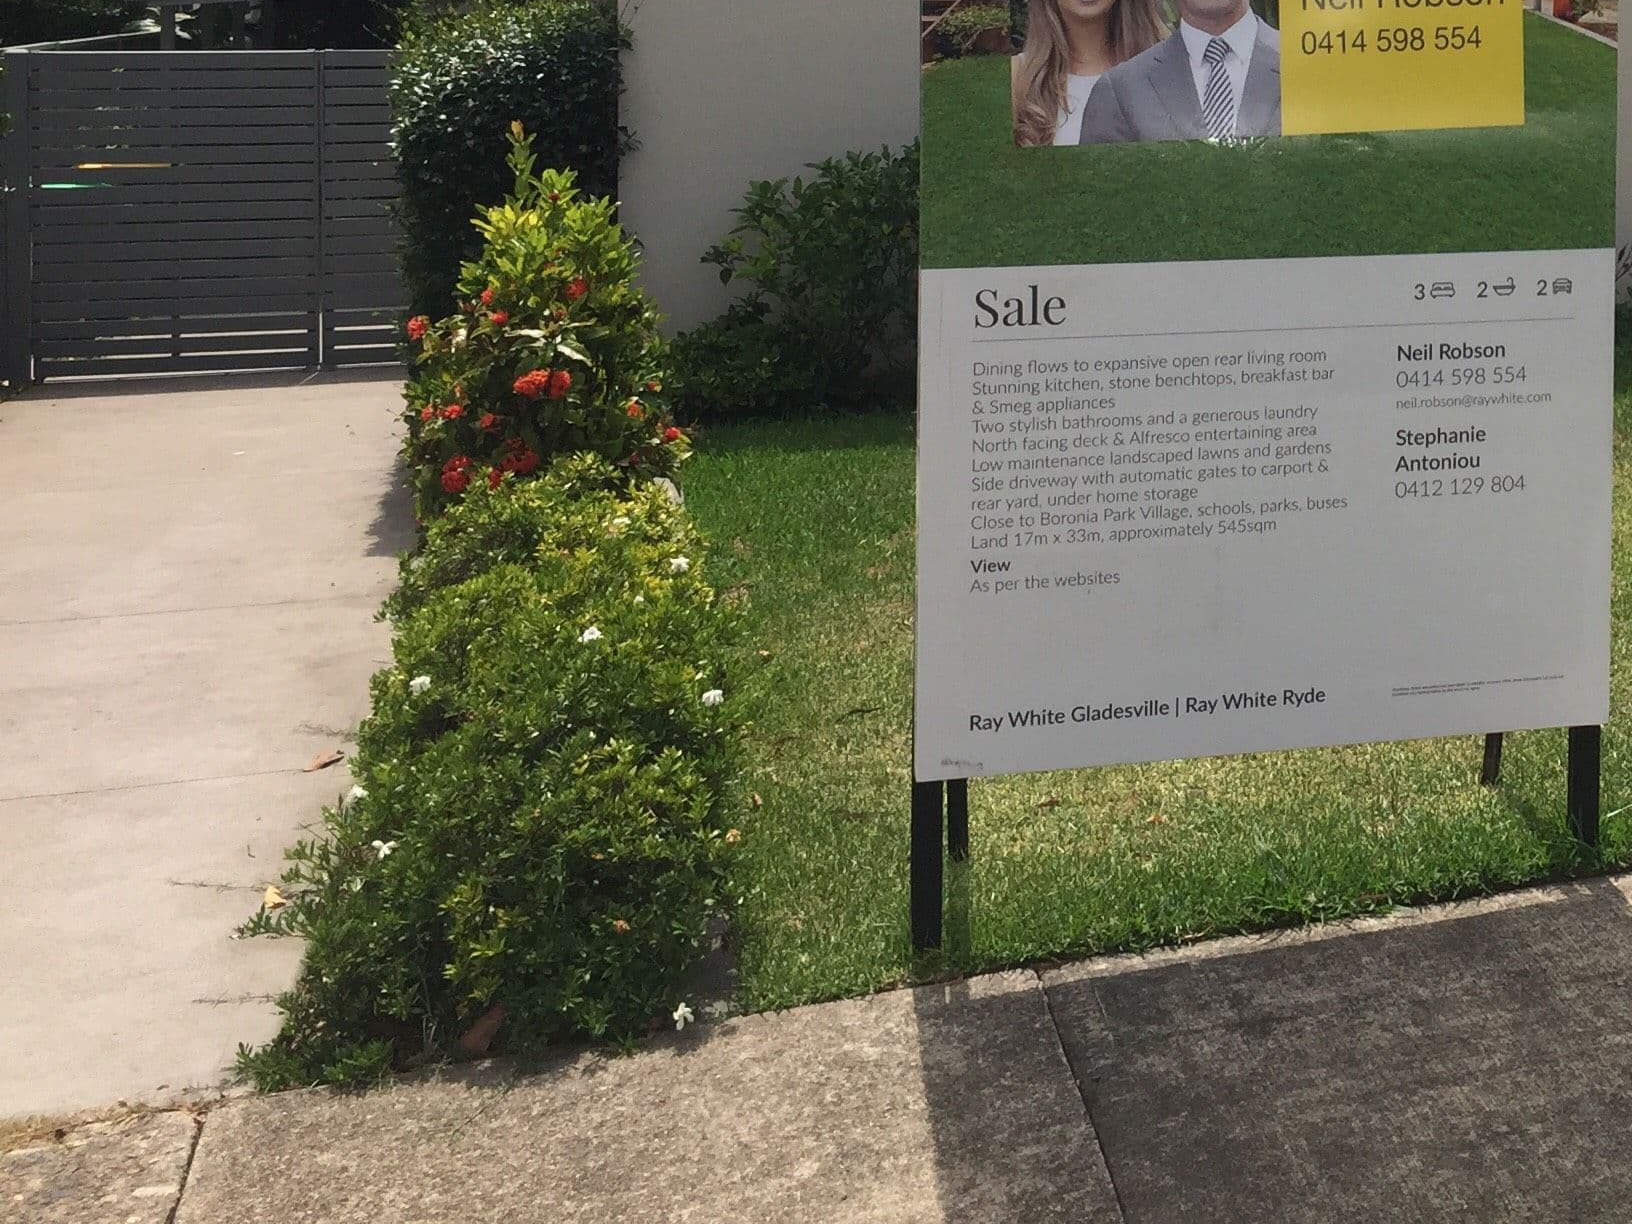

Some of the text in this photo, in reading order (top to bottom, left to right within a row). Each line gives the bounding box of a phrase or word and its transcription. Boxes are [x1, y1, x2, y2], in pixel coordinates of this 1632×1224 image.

[1301, 26, 1482, 55] 0414 598 554
[1414, 280, 1547, 300] 3 2 2
[975, 284, 1067, 328] Sale
[973, 350, 1327, 377] Dining flows to expansive open rear living room
[1397, 343, 1505, 361] Neil Robson
[972, 368, 1335, 396] Stunning kitchen, stone benchtops, breakfast bar
[1396, 366, 1526, 388] 0414 598 554
[972, 397, 1116, 415] & Smeg appliances
[1396, 391, 1551, 410] neil.robson@raywhite.com
[972, 405, 1318, 434] Two stylish bathrooms and a generous laundry
[972, 425, 1317, 453] North facing deck & Alfresco entertaining area
[1396, 426, 1487, 448] Stephanie
[972, 442, 1332, 472] Low maintenance landscaped lawns and gardens
[1395, 452, 1480, 472] Antoniou
[972, 459, 1328, 492] Side driveway with automatic gates to carport &
[1395, 475, 1526, 498] 0412 129 804
[971, 498, 1001, 511] rear
[1048, 492, 1092, 506] under
[1097, 490, 1138, 503] home
[1144, 487, 1198, 501] storage
[971, 516, 1014, 530] Close
[1020, 515, 1034, 526] to
[1040, 511, 1098, 526] Boronia
[1103, 508, 1135, 521] Park
[1198, 500, 1255, 516] schools,
[1307, 497, 1348, 510] buses
[971, 519, 1276, 549] Land 17m x 33m, approximately 545sqm
[970, 559, 1011, 573] View
[970, 571, 1120, 594] As per the websites
[969, 714, 1003, 732] Ray
[1008, 709, 1065, 727] White
[1071, 699, 1169, 723] Gladesville
[1186, 697, 1218, 714] Ray
[1222, 691, 1277, 709] White
[1283, 687, 1326, 707] Ryde
